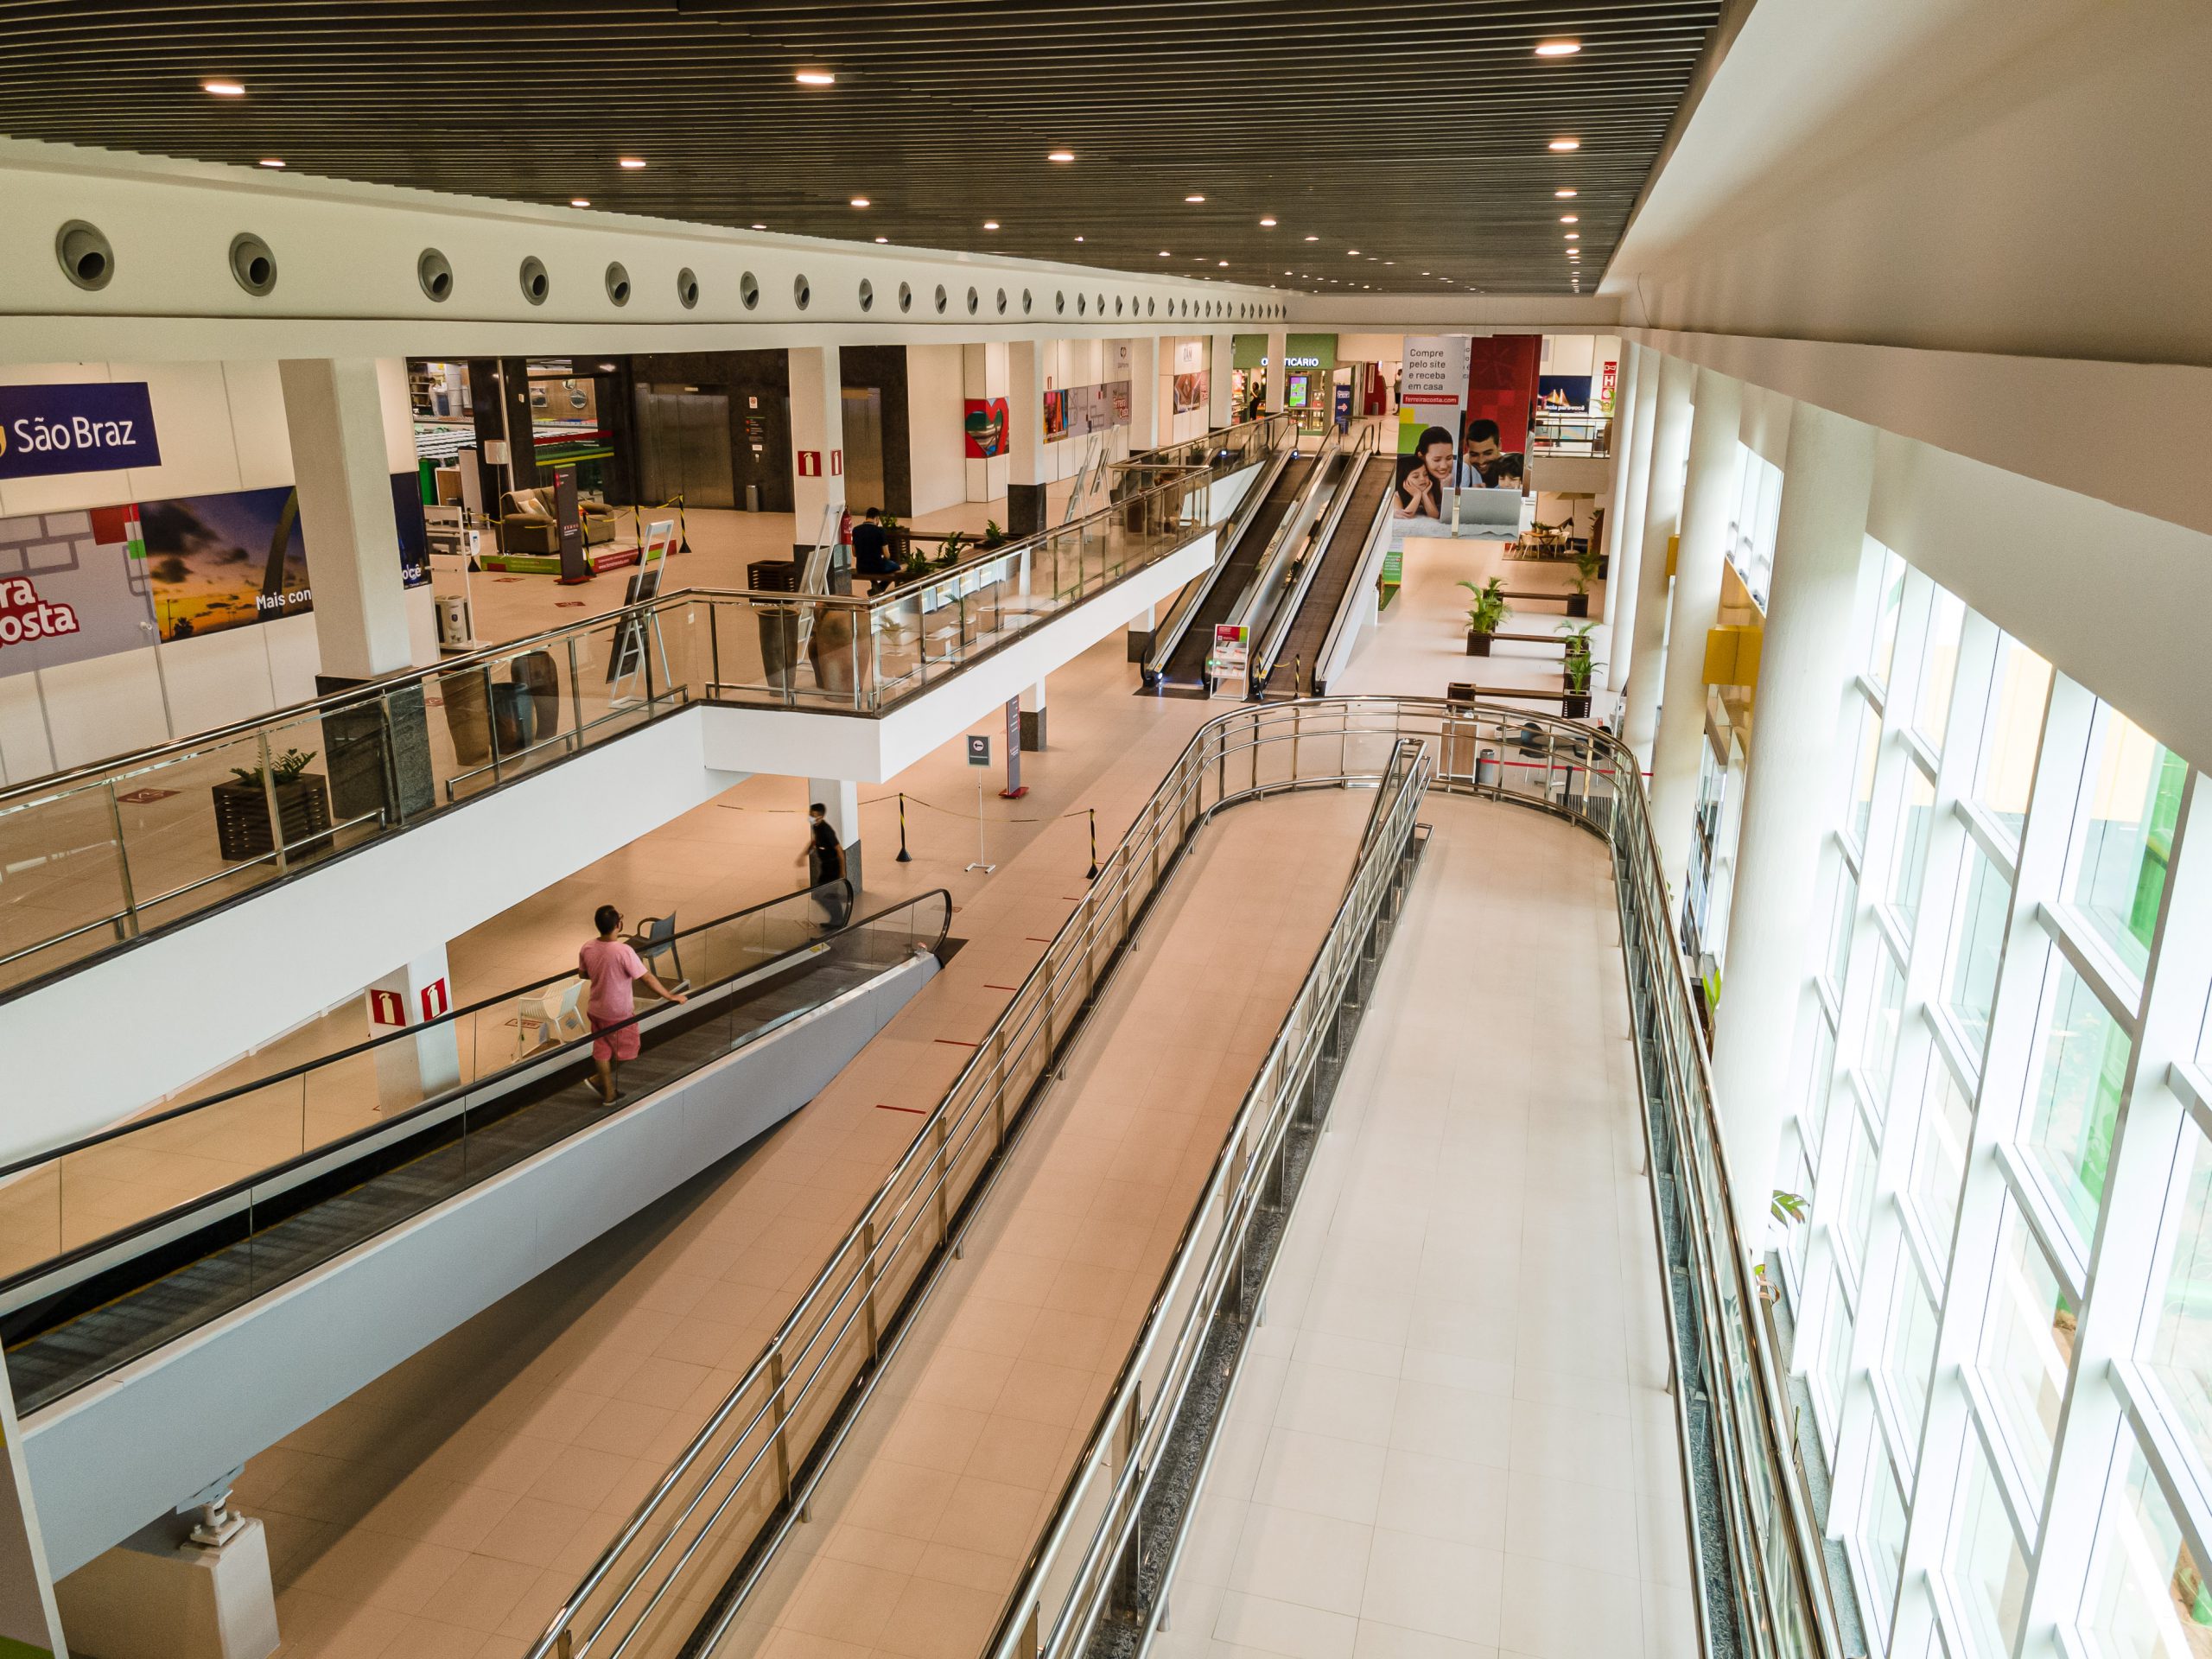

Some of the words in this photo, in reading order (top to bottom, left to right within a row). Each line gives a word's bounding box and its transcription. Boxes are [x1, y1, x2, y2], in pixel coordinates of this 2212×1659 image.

[1409, 348, 1444, 359] Compre
[1409, 360, 1427, 369] pelo
[1604, 375, 1614, 386] H
[14, 416, 71, 454] São
[72, 416, 137, 448] Braz
[0, 579, 36, 608] ra
[256, 591, 286, 610] Mais
[288, 589, 312, 604] con
[0, 603, 77, 642] osta
